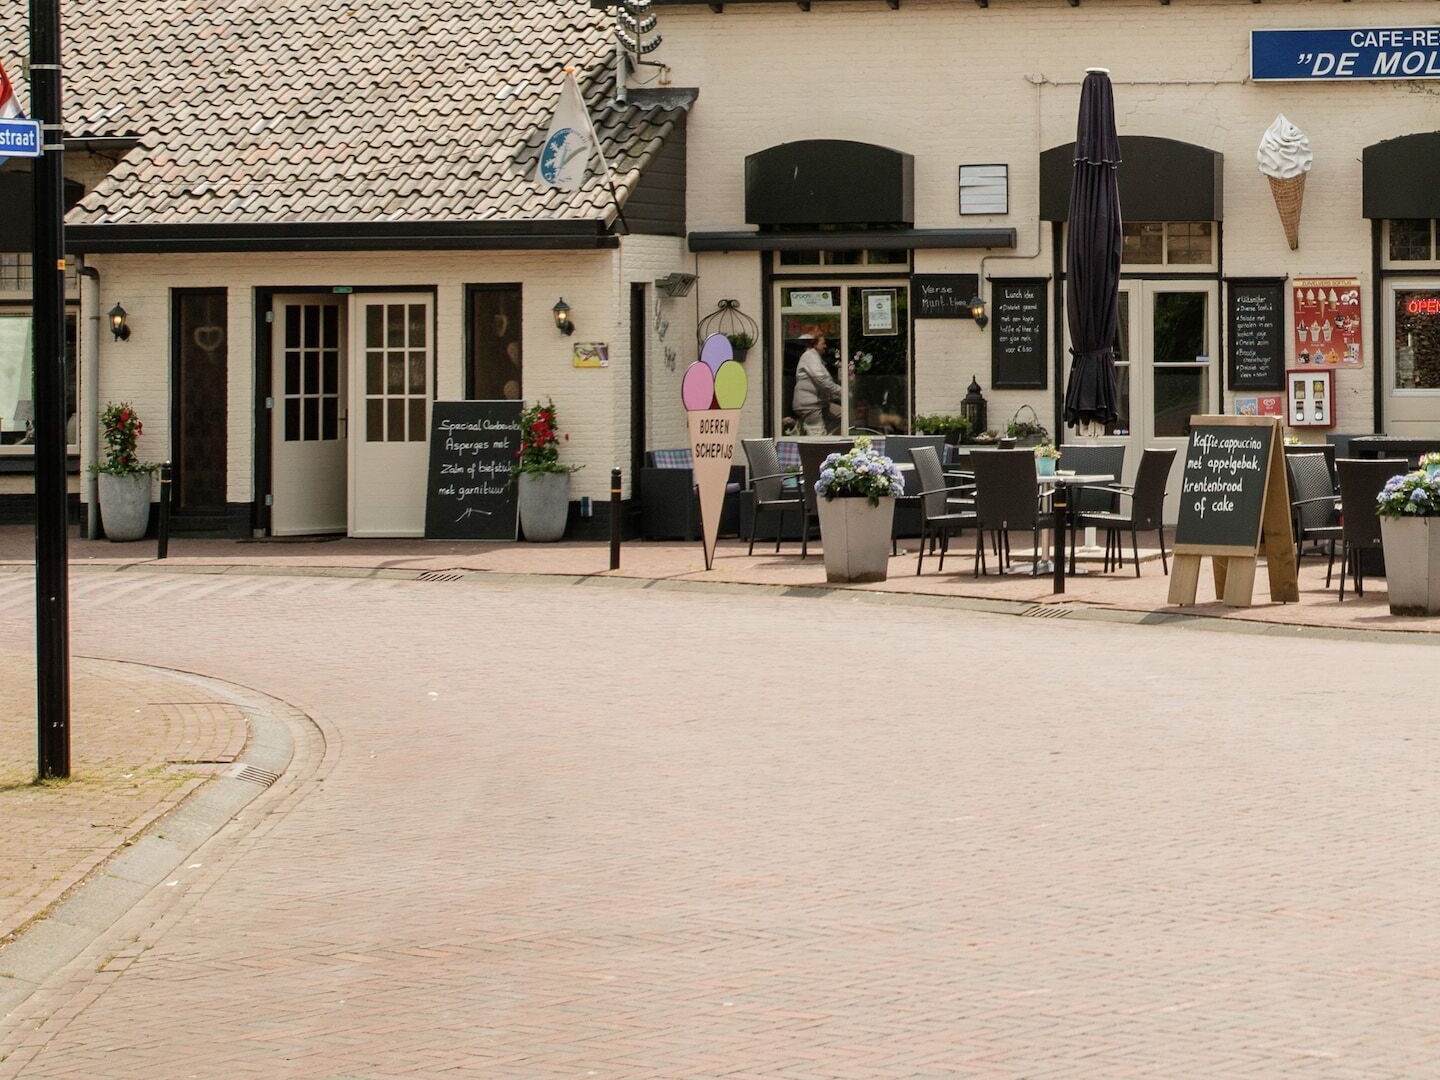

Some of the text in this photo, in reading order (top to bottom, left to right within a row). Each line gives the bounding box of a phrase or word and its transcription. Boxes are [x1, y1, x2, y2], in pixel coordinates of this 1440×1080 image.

[700, 419, 730, 434] BOEREN
[695, 443, 733, 459] SCHEPIJS
[1187, 456, 1202, 469] met
[1183, 476, 1243, 493] krentenbrood
[1194, 494, 1234, 519] of cake
